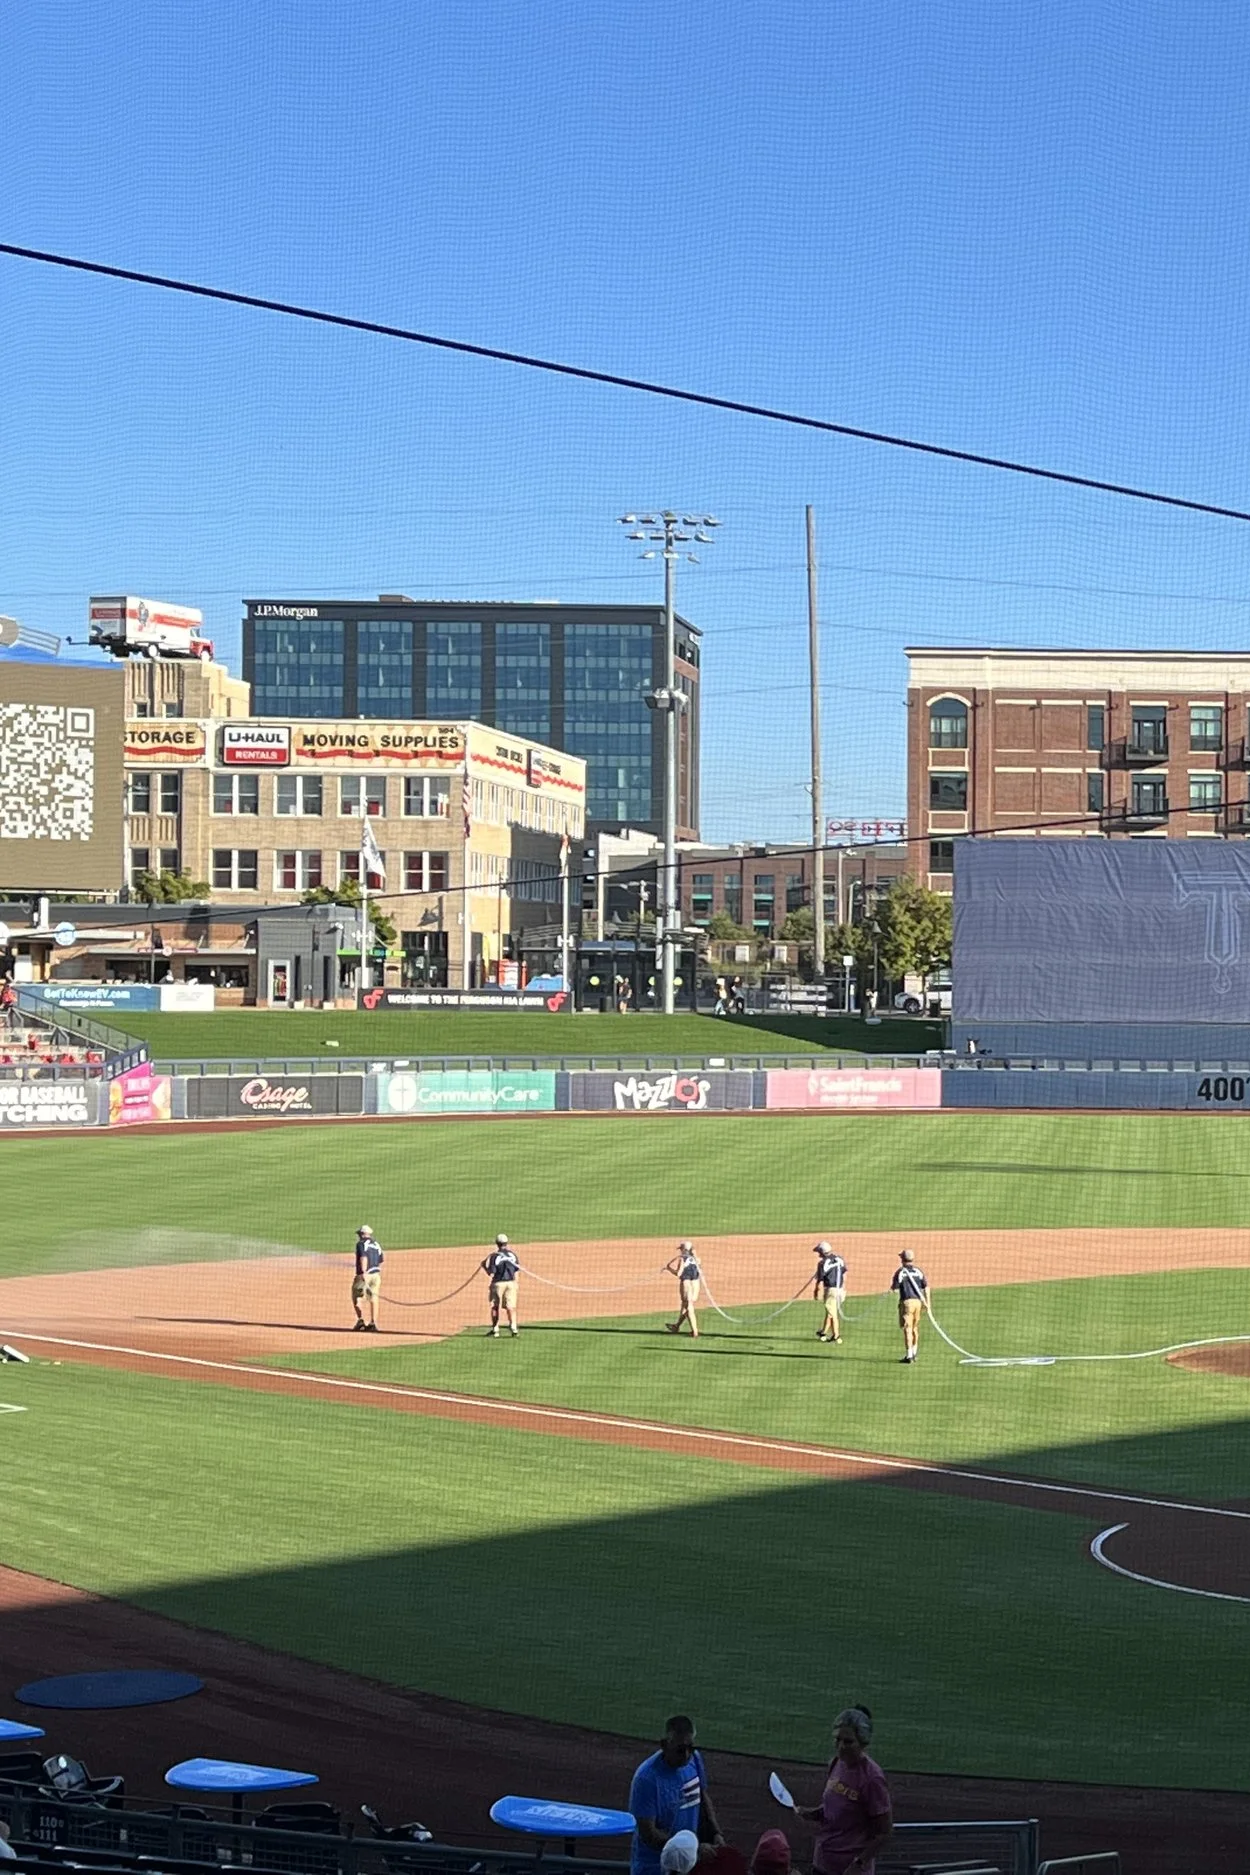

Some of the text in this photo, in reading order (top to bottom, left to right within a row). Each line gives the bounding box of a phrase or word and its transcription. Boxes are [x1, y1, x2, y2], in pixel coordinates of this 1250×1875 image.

[228, 733, 284, 743] U-HAUL
[303, 735, 459, 748] MOVING SUPPLIES
[235, 750, 278, 760] RENTALS
[20, 1086, 88, 1104] BASEBALL
[418, 1086, 540, 1104] CommunityCare
[40, 1815, 57, 1828] 110
[40, 1829, 57, 1842] 111
